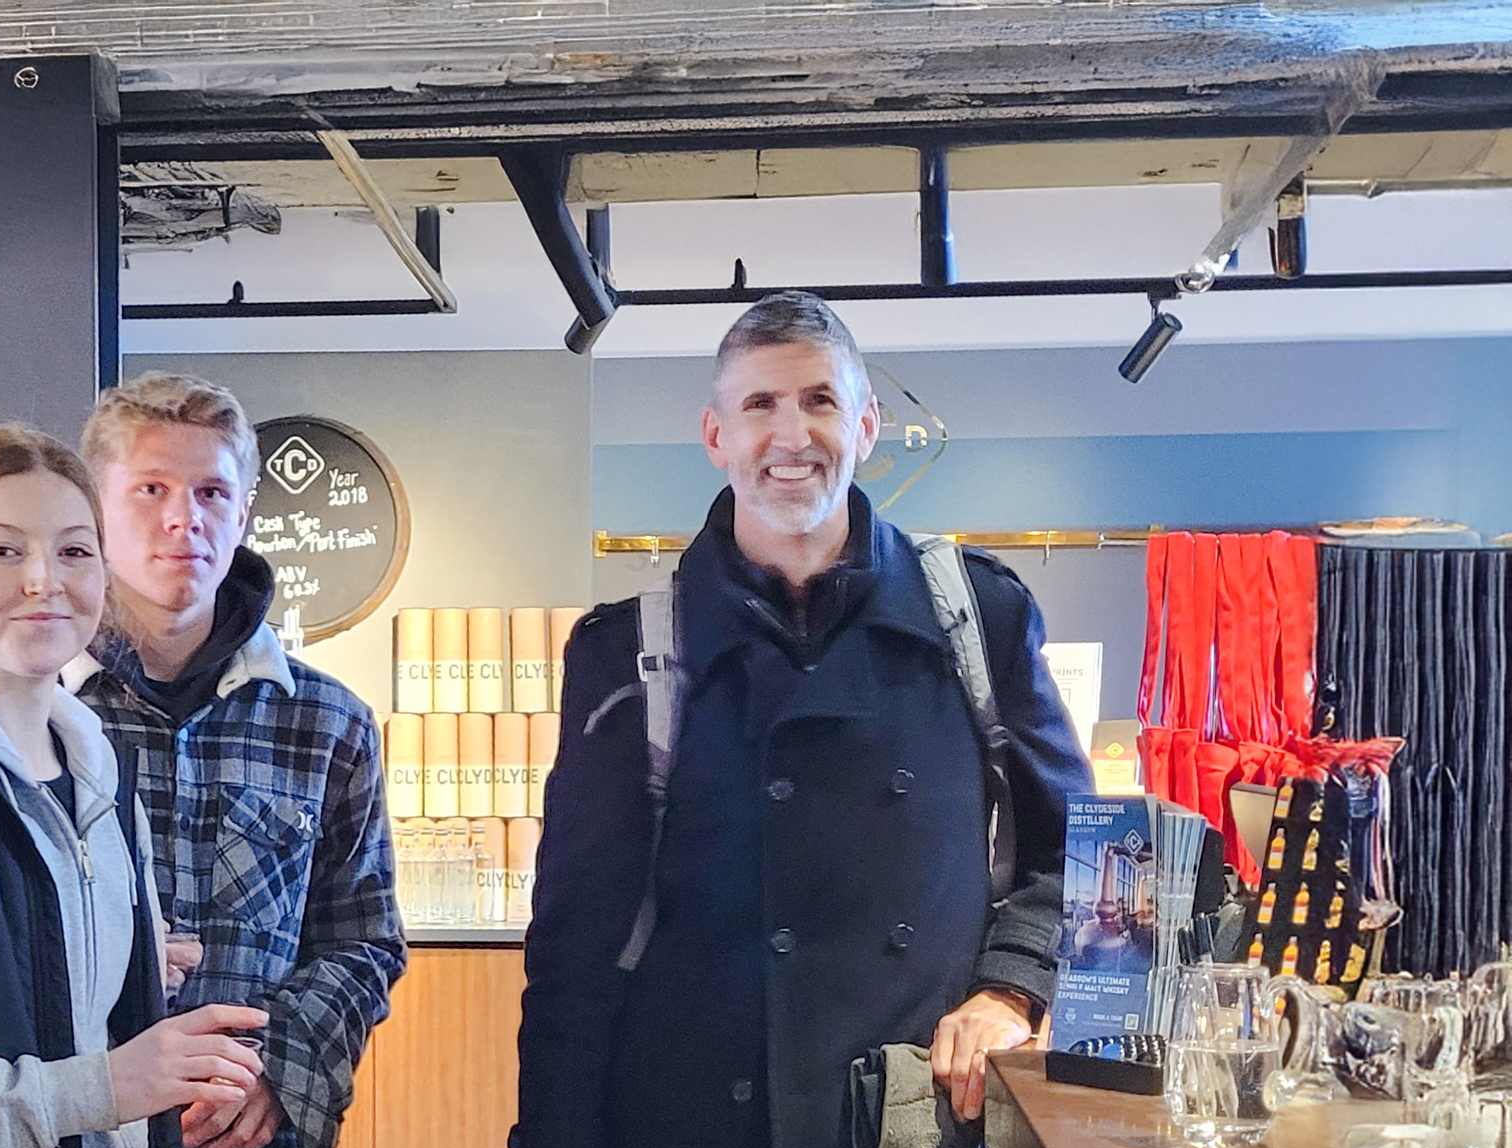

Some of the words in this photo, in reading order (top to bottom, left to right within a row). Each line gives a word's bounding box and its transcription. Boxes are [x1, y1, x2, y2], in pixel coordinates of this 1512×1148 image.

[329, 468, 360, 489] Year
[328, 486, 368, 506] 2018
[253, 515, 285, 533] Cask
[288, 510, 321, 537] Type
[337, 528, 376, 549] Finish
[275, 565, 307, 583] ABV
[1068, 804, 1083, 813] THE
[1085, 804, 1125, 814] CLYDESIDE
[1068, 815, 1113, 825] DISTILLERY
[1098, 976, 1130, 986] ULTIMATE
[1058, 991, 1098, 1001] EXPERIENCE
[1084, 984, 1101, 992] MALT
[1102, 986, 1129, 995] WHISKY
